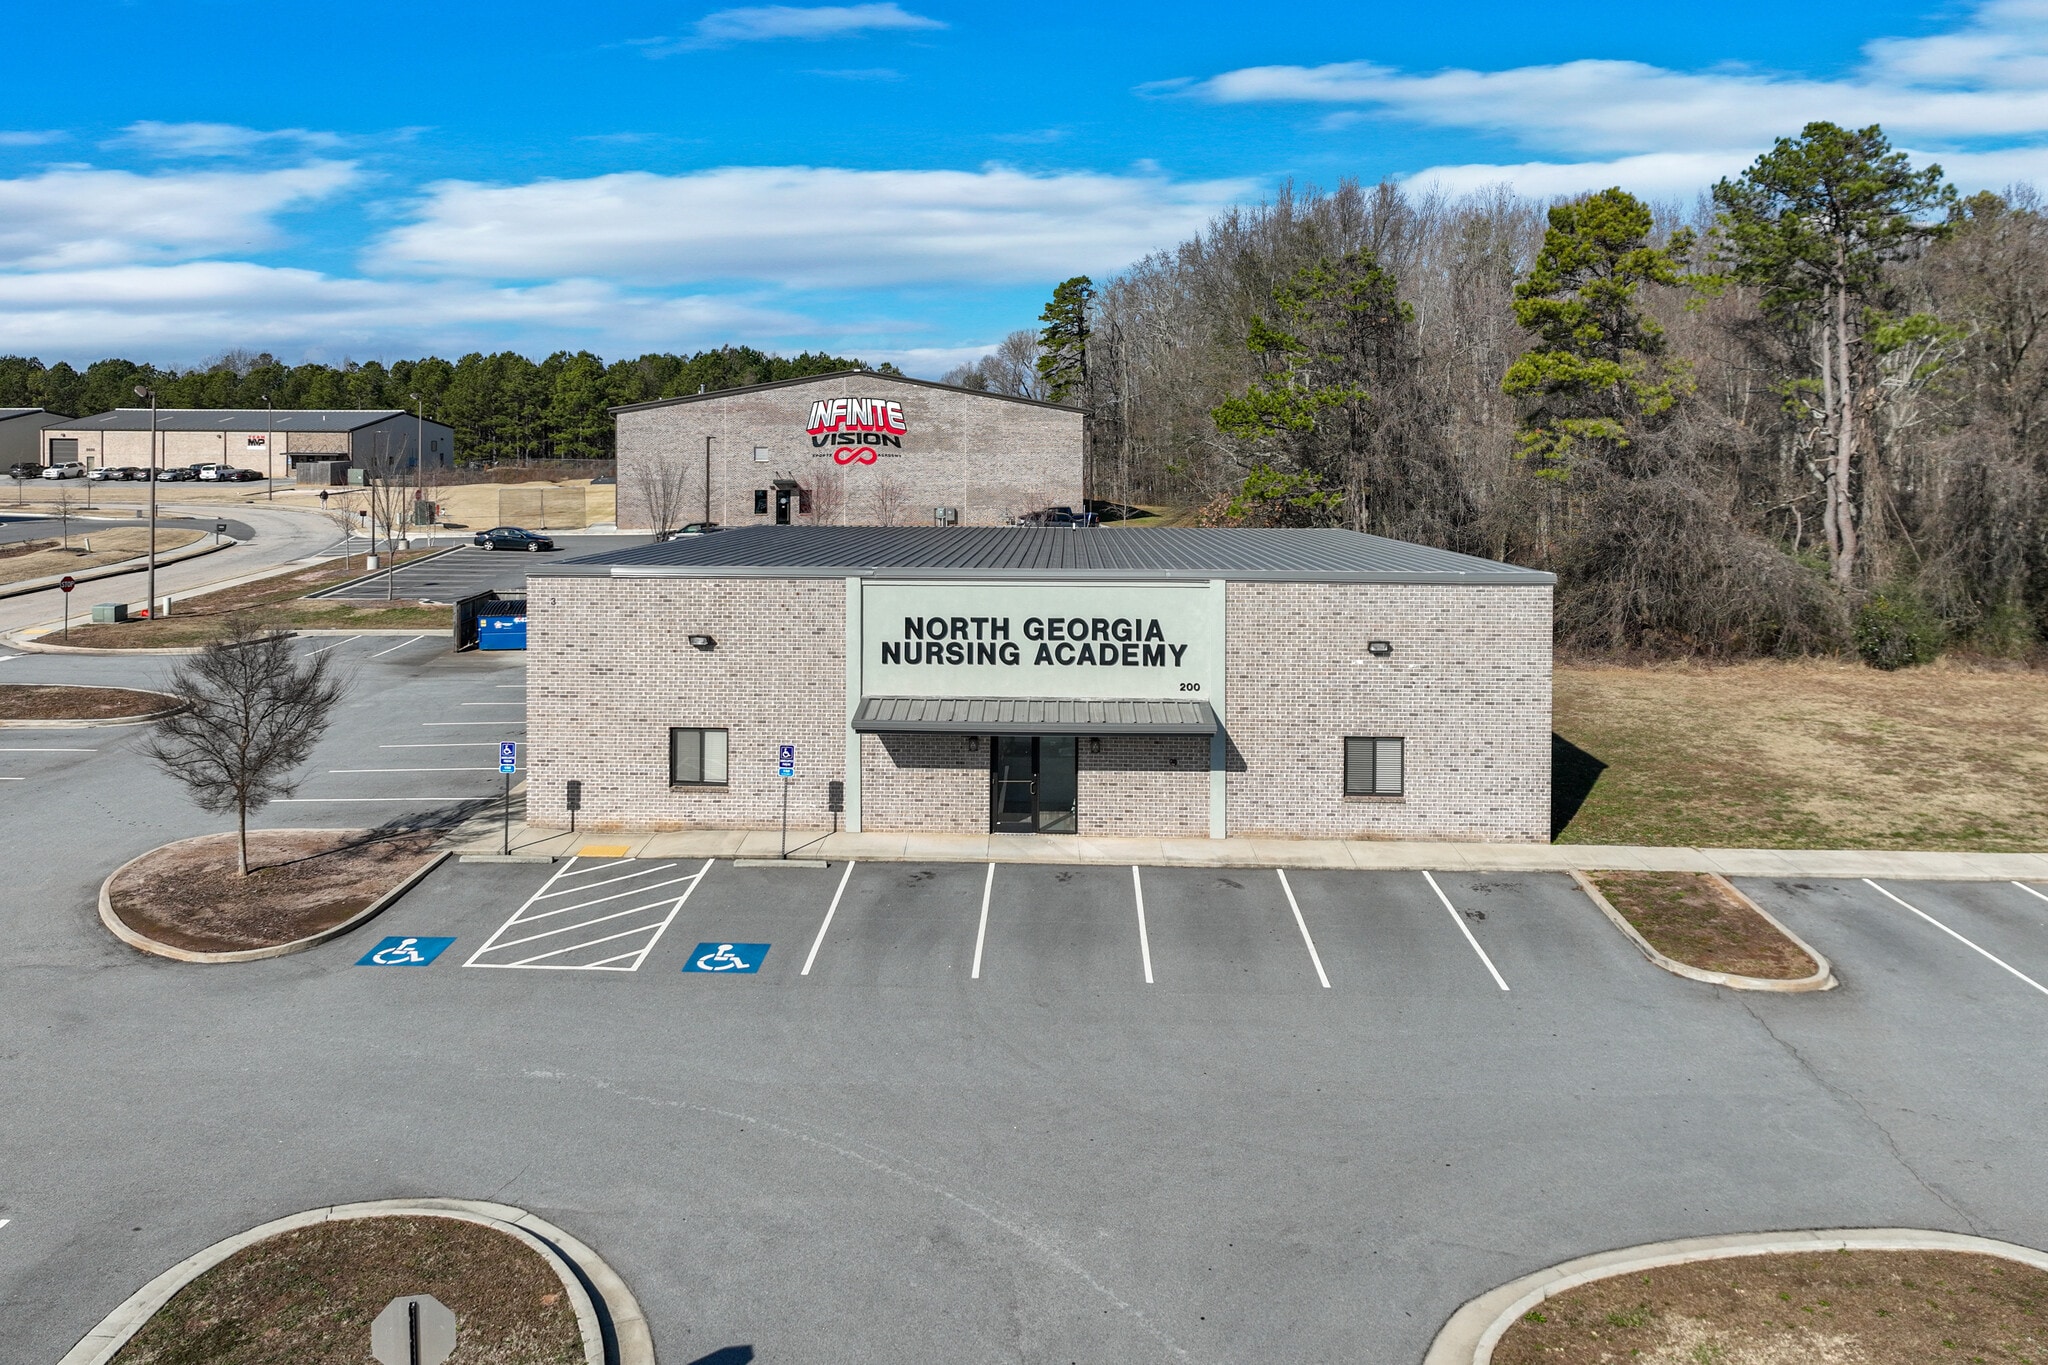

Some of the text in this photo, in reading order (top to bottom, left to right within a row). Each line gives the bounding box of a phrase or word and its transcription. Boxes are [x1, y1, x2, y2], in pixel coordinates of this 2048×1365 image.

[806, 397, 907, 435] INFINITE
[811, 432, 902, 448] VISION
[904, 616, 1165, 642] NORTH GEORGIA
[881, 641, 1188, 667] NURSING ACADEMY
[1179, 682, 1201, 692] 200
